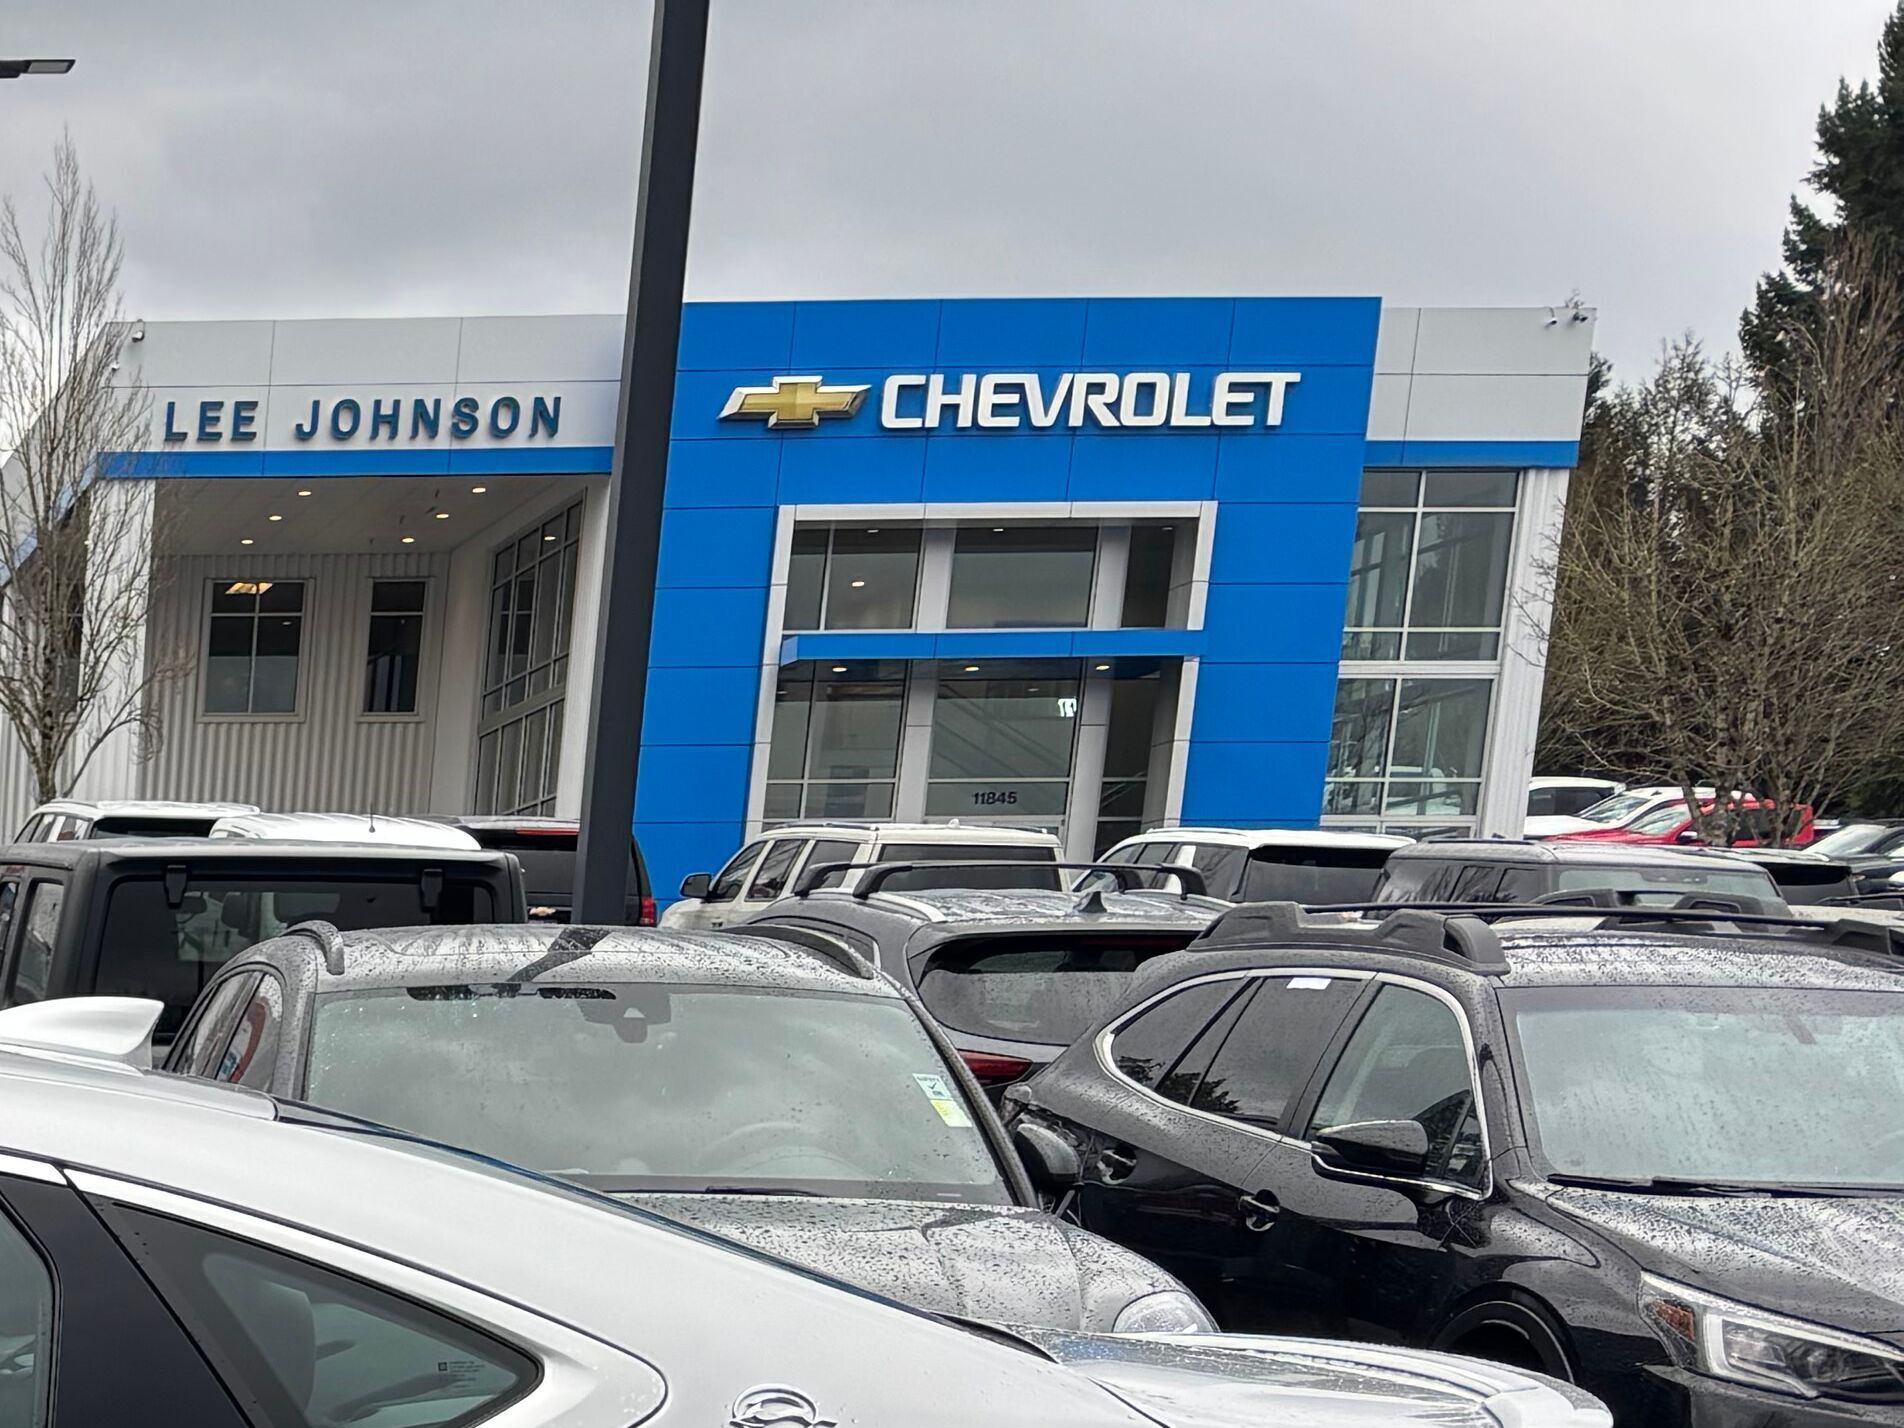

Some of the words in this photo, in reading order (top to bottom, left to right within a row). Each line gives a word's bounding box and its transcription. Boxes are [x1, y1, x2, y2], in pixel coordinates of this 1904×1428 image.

[165, 400, 259, 442] LEE
[295, 396, 562, 441] JOHNSON
[881, 372, 1301, 428] CHEVROLET
[973, 791, 1017, 805] 11845
